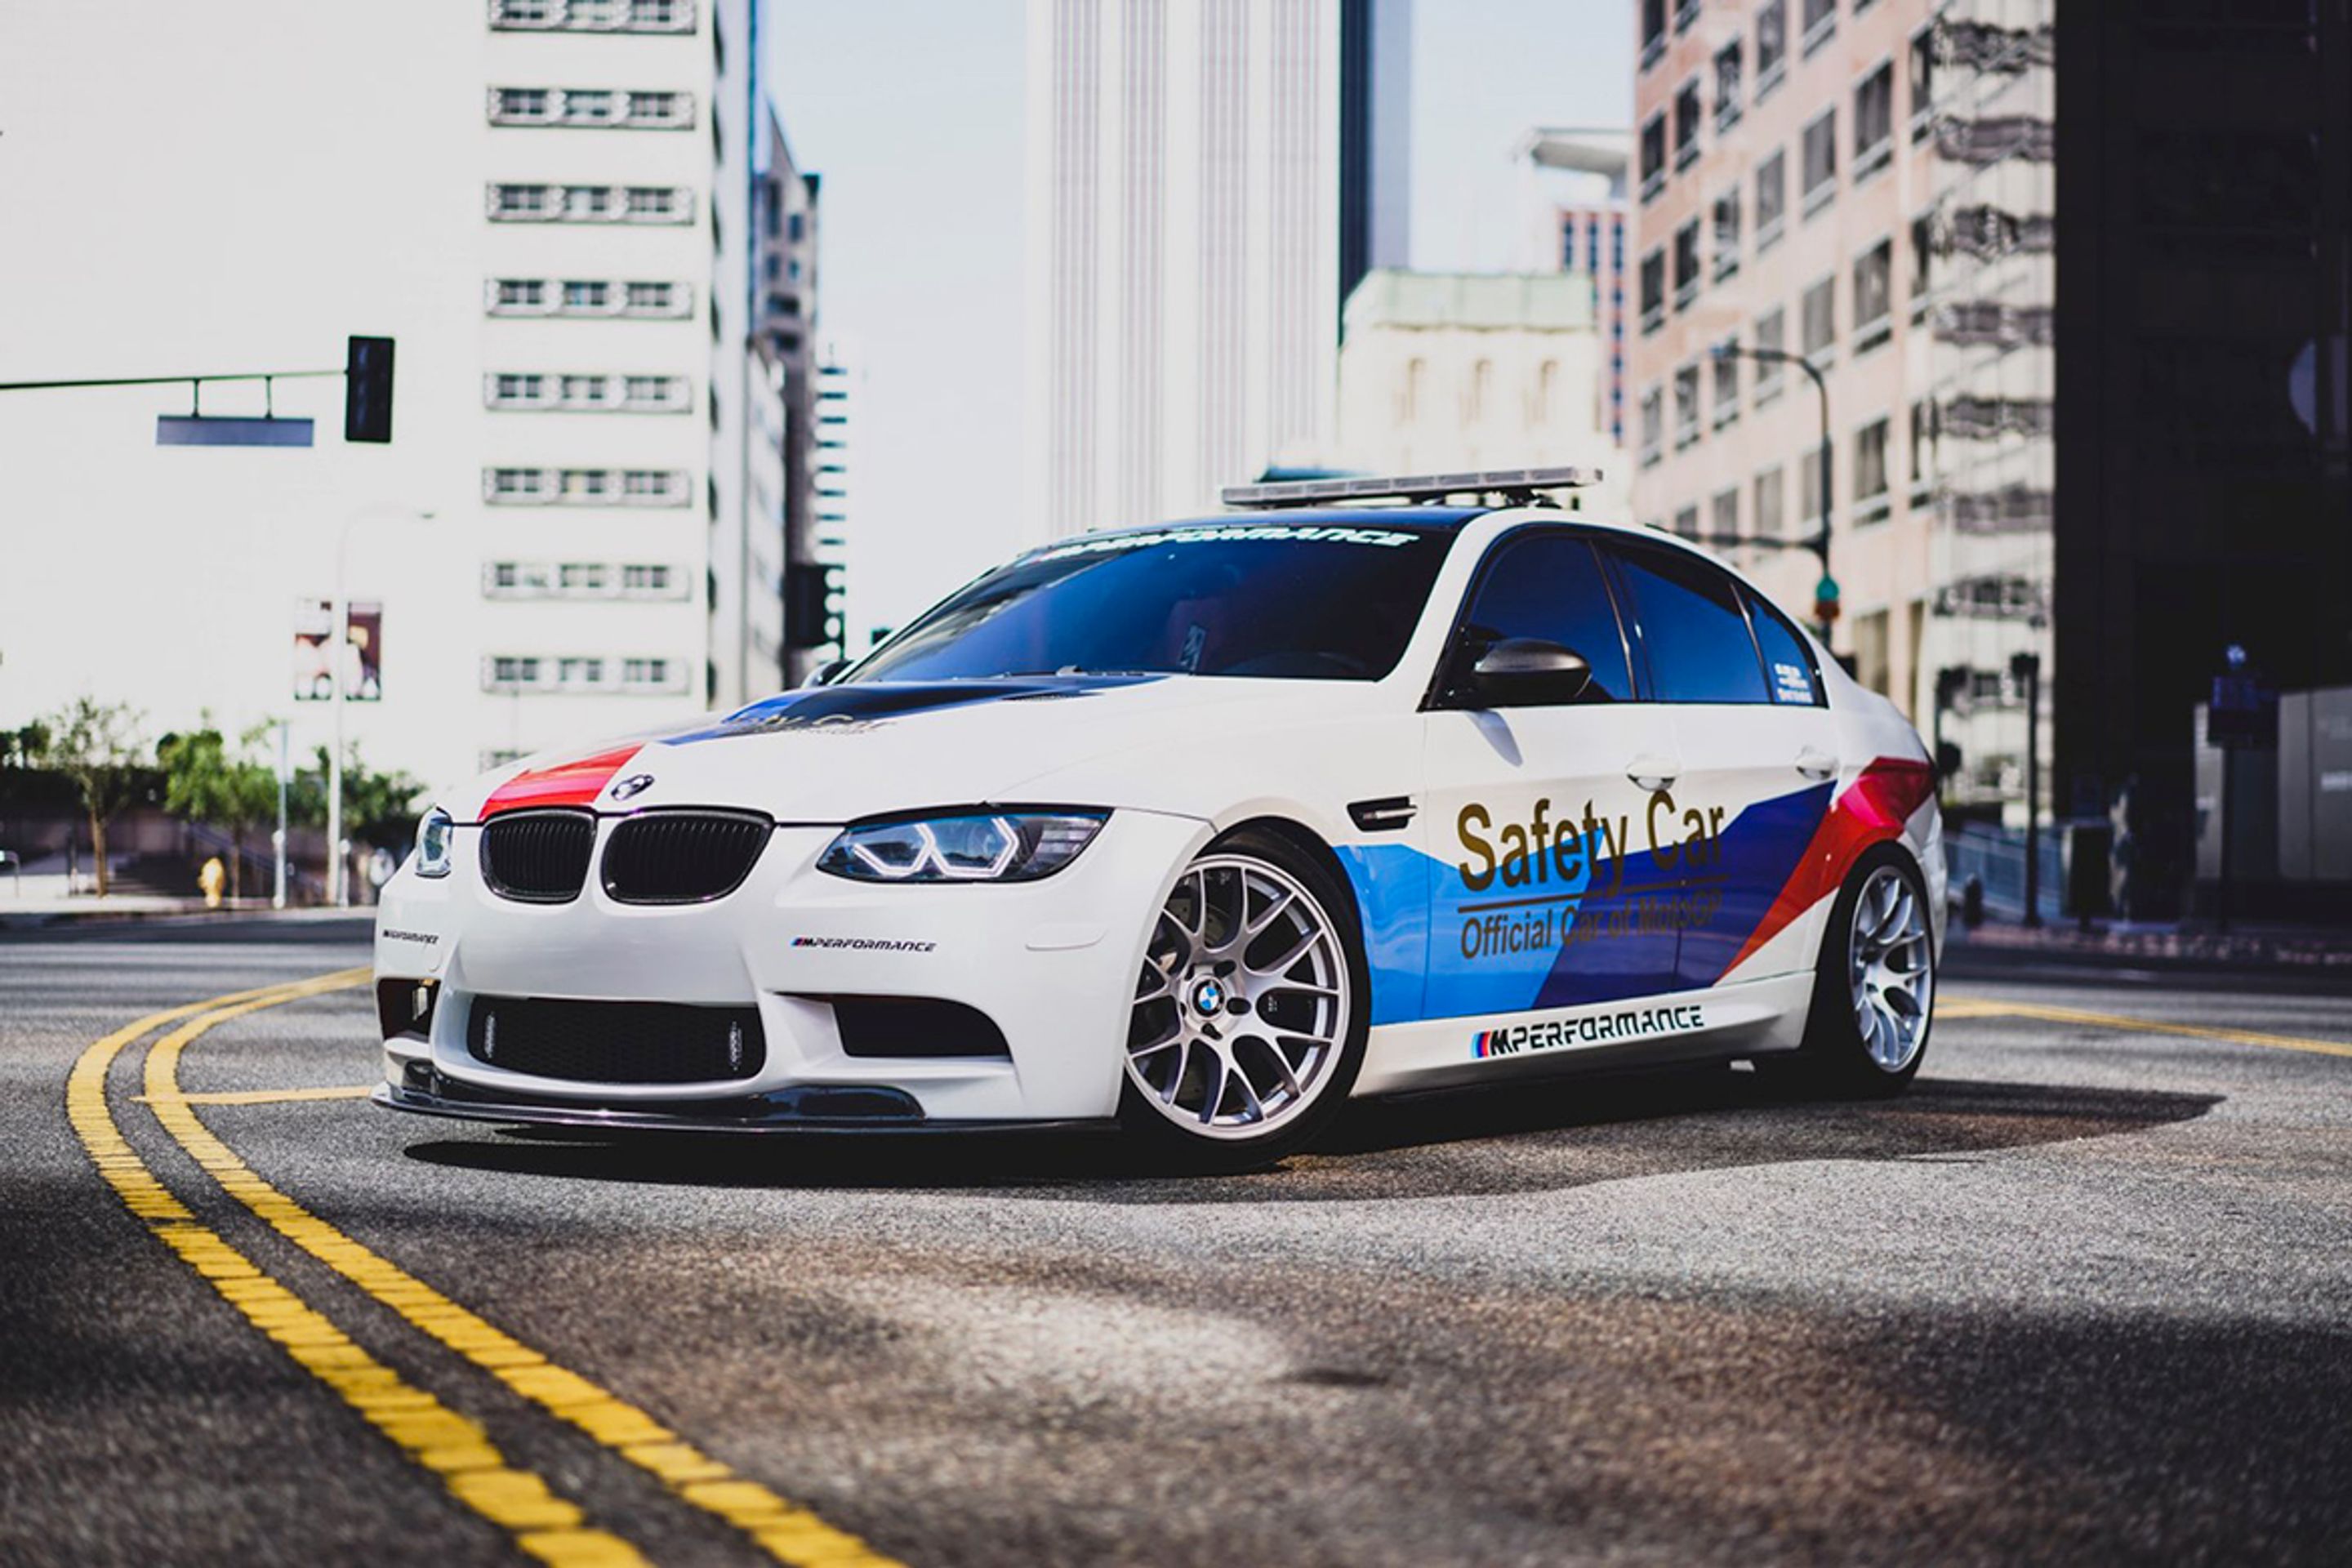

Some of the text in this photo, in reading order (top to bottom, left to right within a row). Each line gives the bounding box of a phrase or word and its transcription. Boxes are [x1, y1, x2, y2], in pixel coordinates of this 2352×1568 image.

[1458, 789, 1725, 897] Safety Car
[1460, 909, 1552, 960] Official
[1560, 904, 1601, 947] Car
